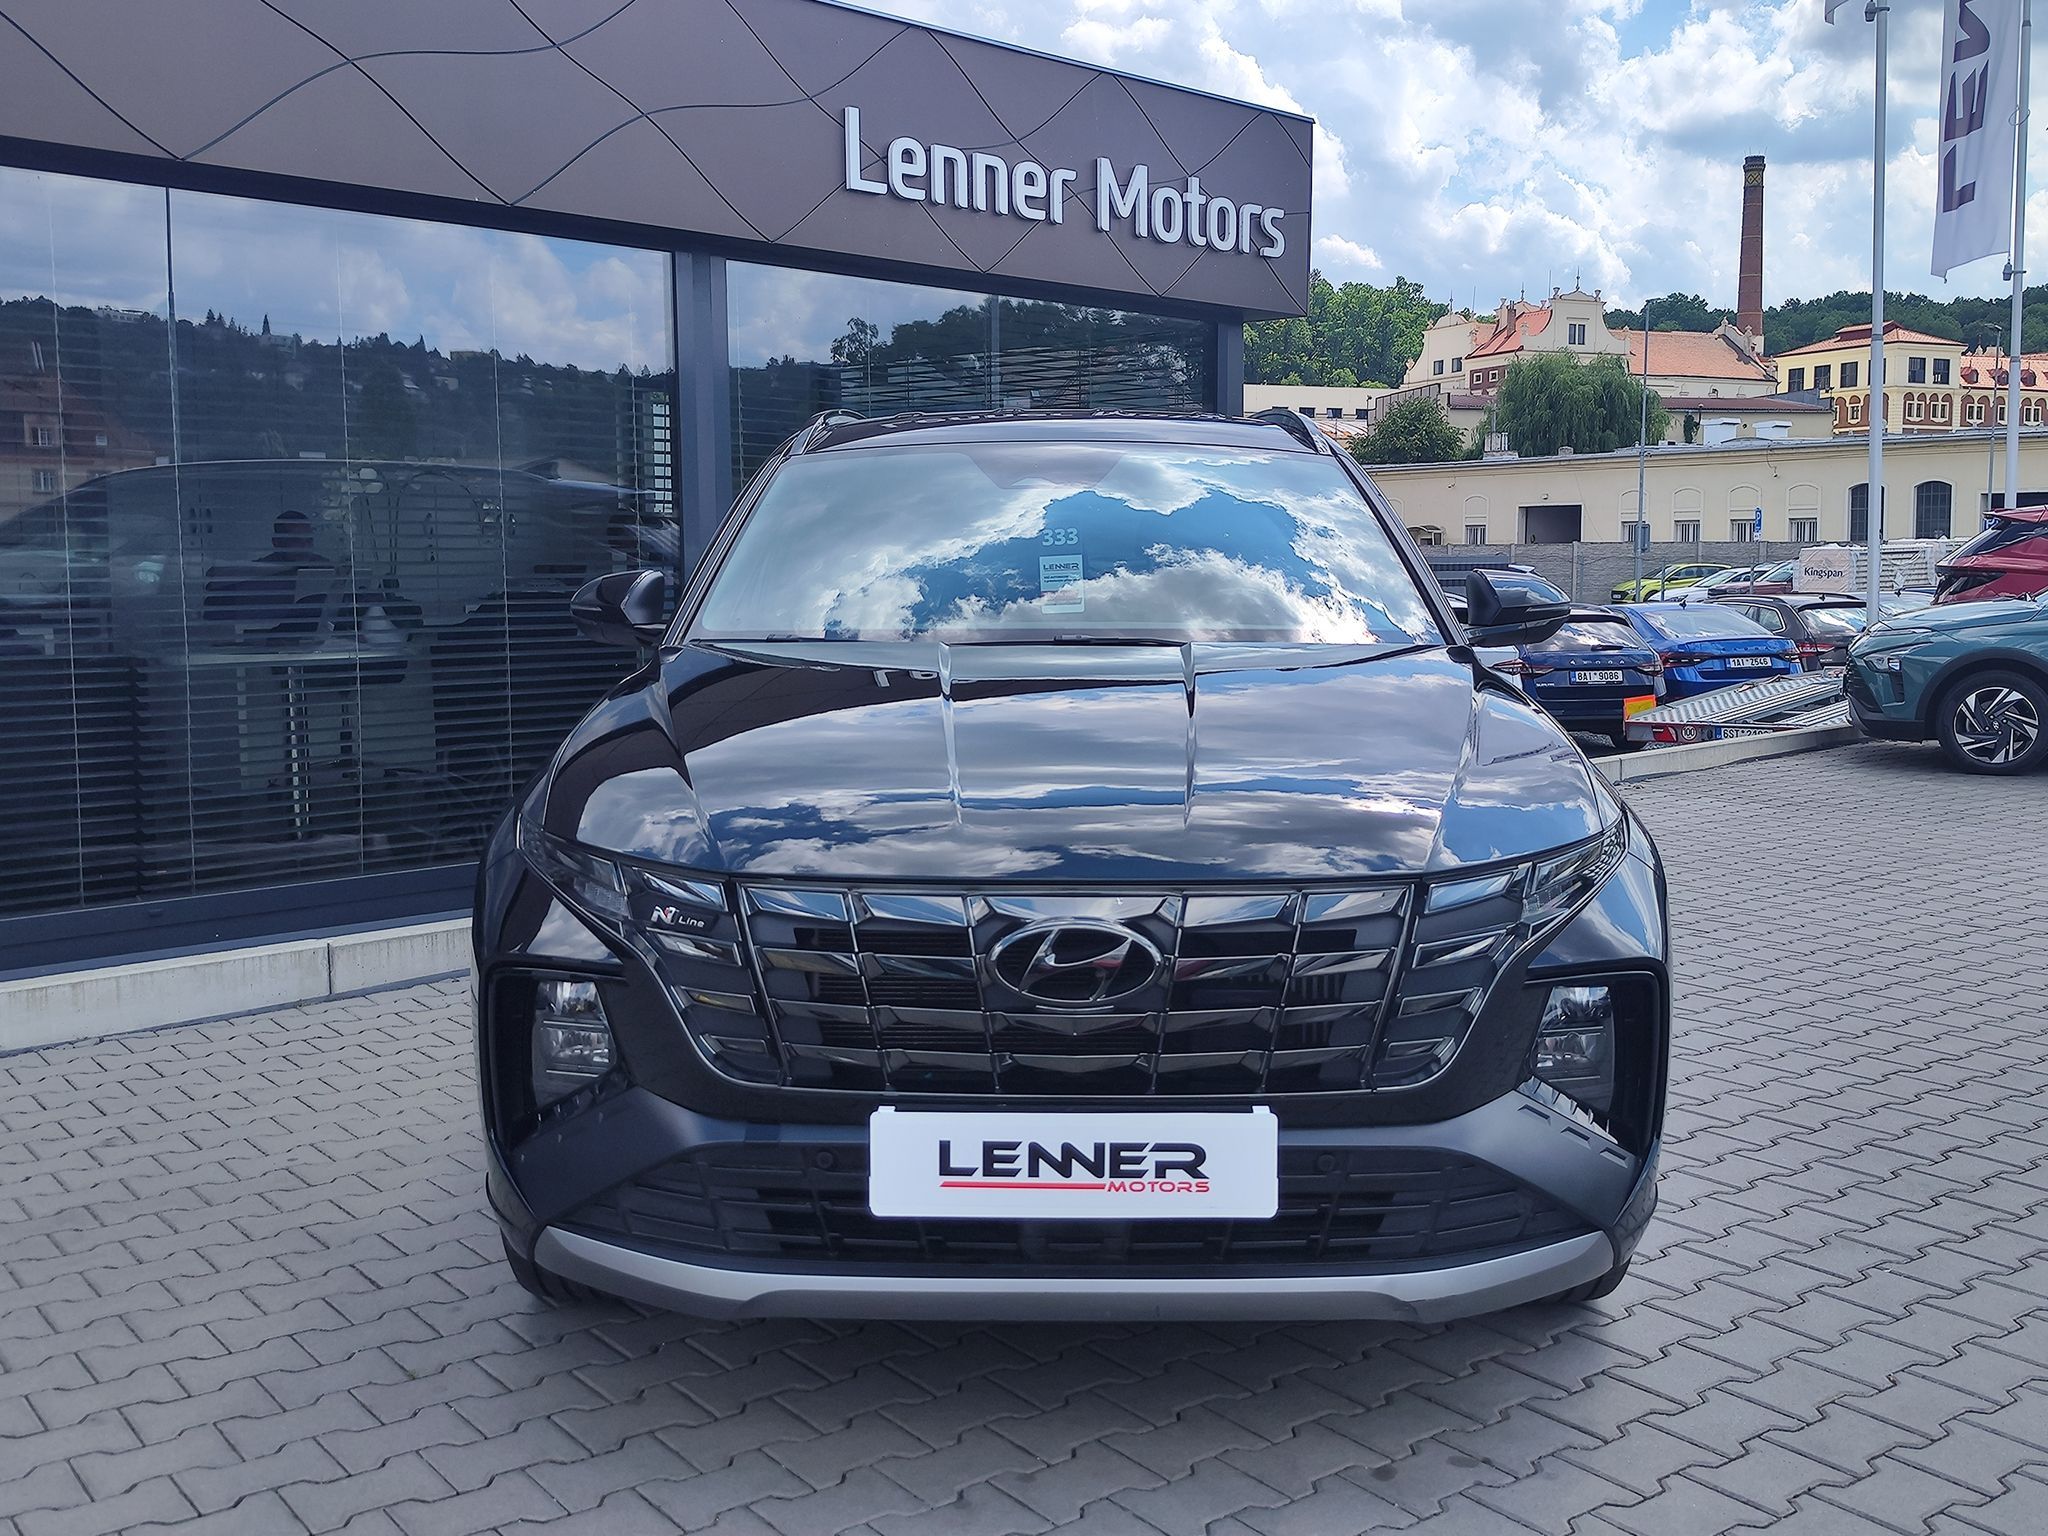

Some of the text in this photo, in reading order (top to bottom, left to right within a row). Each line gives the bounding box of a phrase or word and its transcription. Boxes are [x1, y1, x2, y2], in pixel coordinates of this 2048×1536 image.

[843, 106, 1286, 259] Lenner Motors
[1042, 527, 1079, 546] 333
[1804, 567, 1843, 579] Kingspan
[1732, 658, 1745, 666] 1AI
[1577, 671, 1619, 681] 8AI 9086
[1723, 729, 1740, 739] 6ST
[650, 905, 705, 928] N Line
[938, 1140, 1210, 1179] LENNER
[1107, 1180, 1210, 1193] MOTORS
